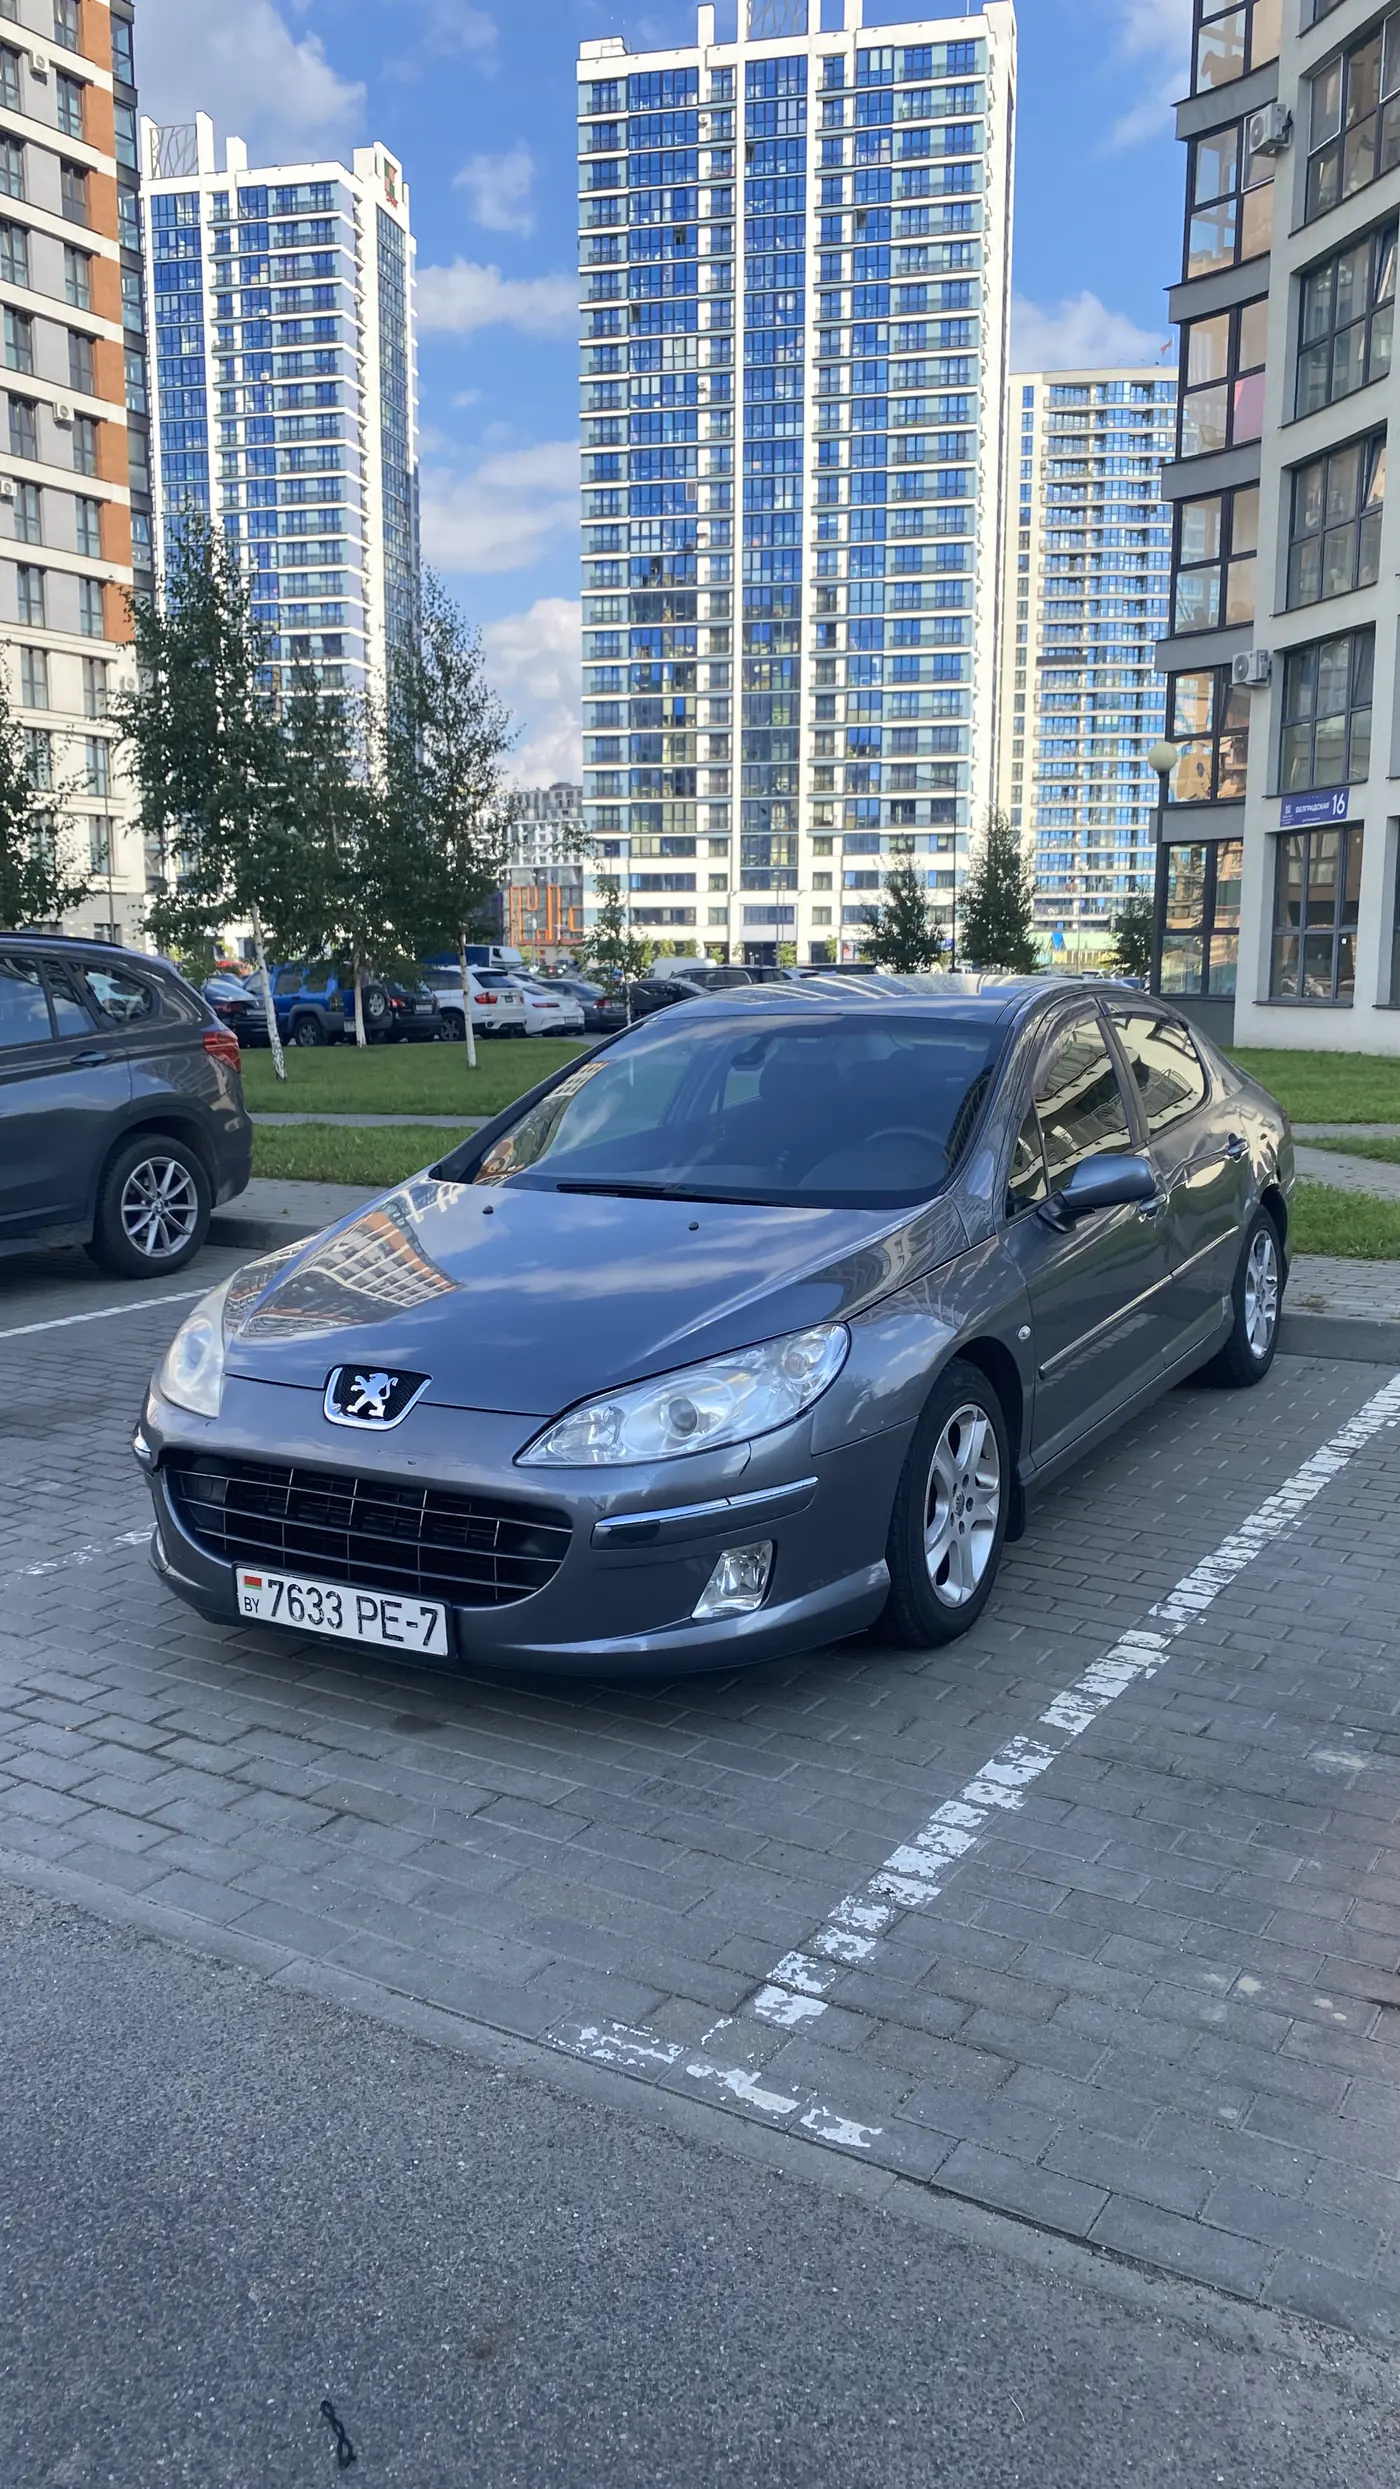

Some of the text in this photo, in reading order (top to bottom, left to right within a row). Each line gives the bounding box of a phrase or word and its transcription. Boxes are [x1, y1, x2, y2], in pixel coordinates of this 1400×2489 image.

[1332, 793, 1345, 815] 16
[244, 1597, 259, 1613] BY
[268, 1579, 438, 1646] 7633 PE-7
